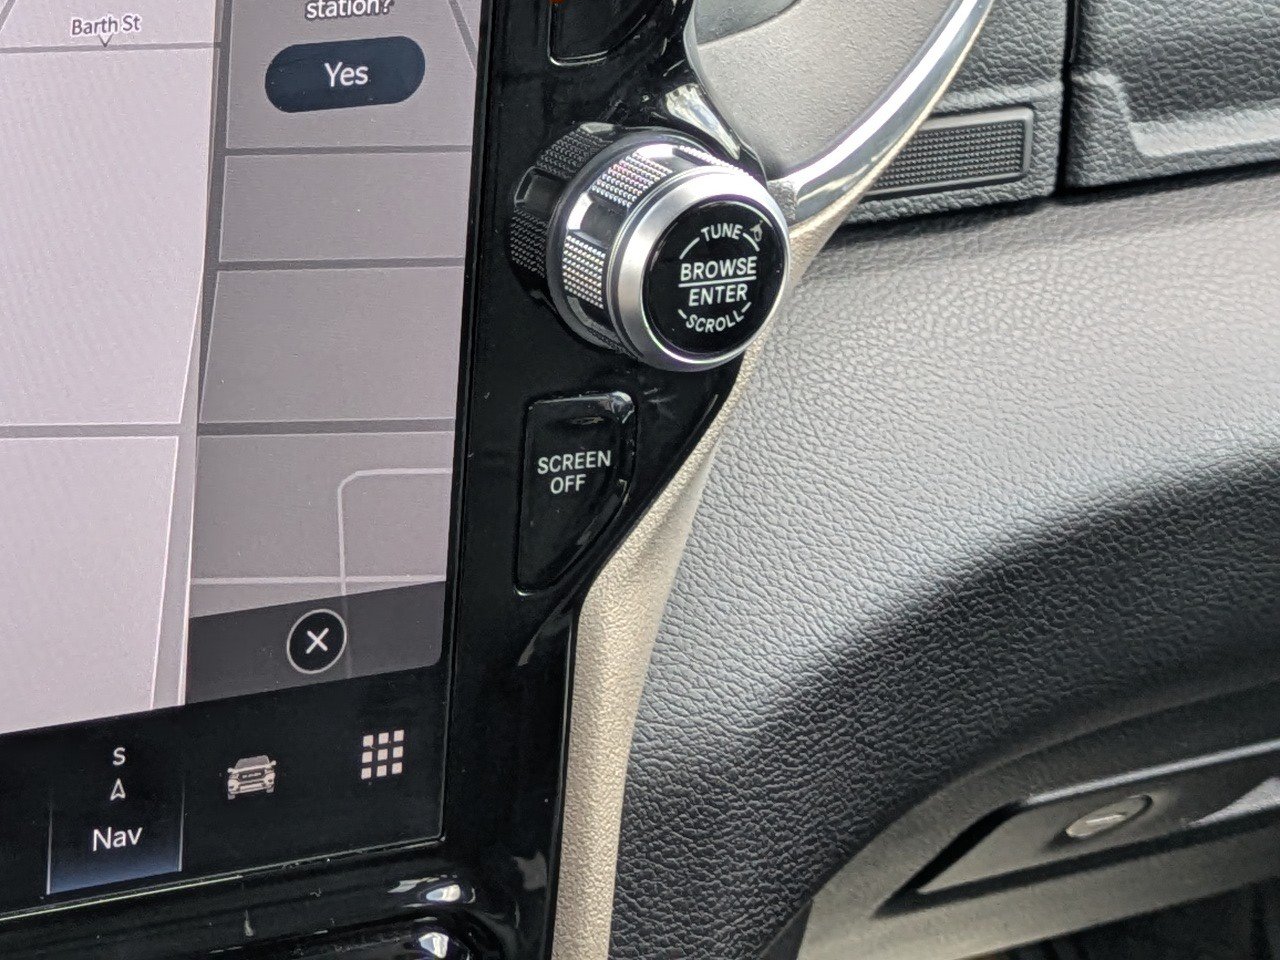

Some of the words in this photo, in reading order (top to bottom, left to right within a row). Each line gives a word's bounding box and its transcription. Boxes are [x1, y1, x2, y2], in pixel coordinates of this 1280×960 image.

[71, 17, 118, 36] Barth
[122, 15, 141, 32] St
[324, 61, 370, 88] Yes
[700, 222, 744, 242] TUNE
[679, 256, 758, 282] BROWSE
[688, 284, 748, 308] ENTER
[685, 309, 745, 333] SCROLL
[536, 450, 612, 475] SCREEN
[549, 474, 587, 495] OFF
[112, 747, 126, 767] S
[92, 825, 144, 852] Nav
